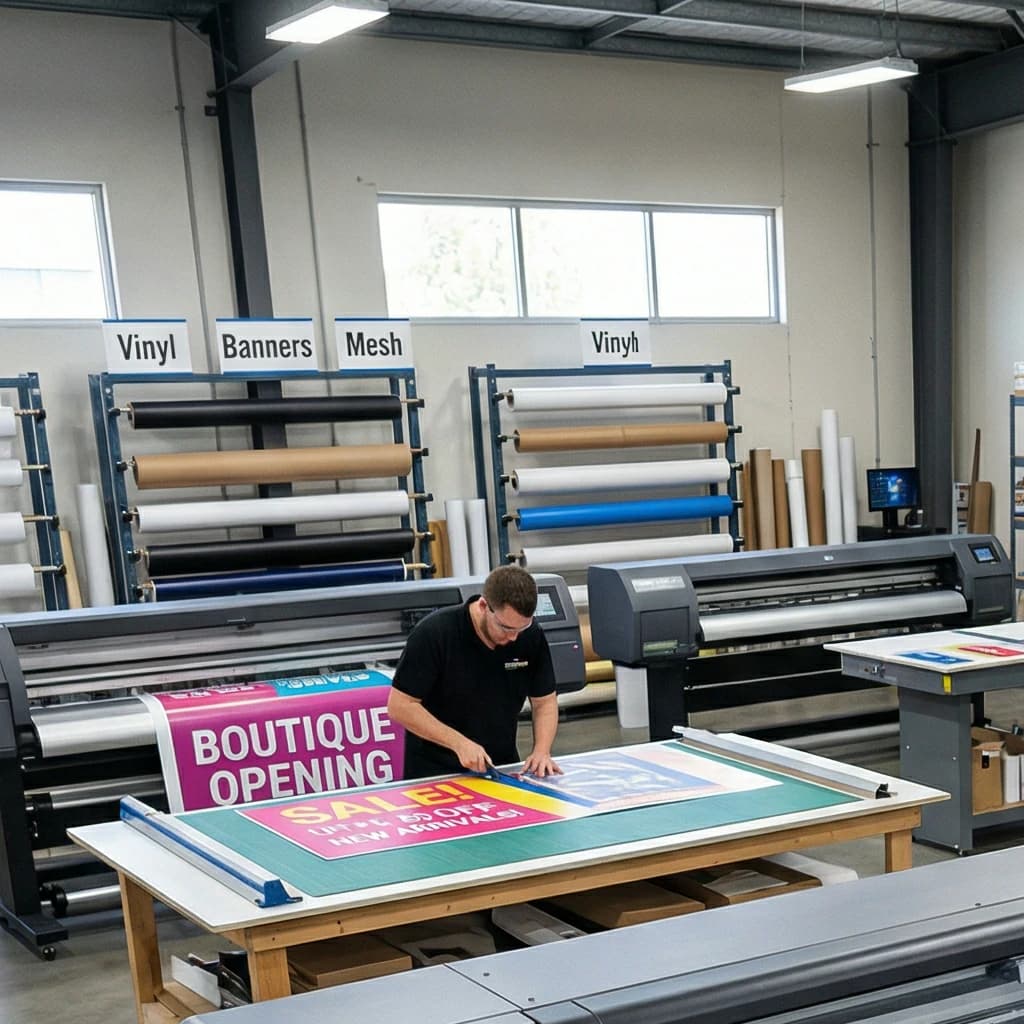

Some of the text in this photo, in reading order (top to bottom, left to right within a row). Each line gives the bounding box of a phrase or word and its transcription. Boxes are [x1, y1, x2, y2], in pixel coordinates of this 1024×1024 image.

[117, 333, 177, 366] Vinyl
[222, 333, 312, 358] Banners
[346, 332, 402, 356] Mesh
[591, 330, 639, 358] Vinyh
[192, 706, 395, 765] BOUTIQUE
[209, 750, 393, 806] OPENING
[280, 781, 475, 825] SALE!
